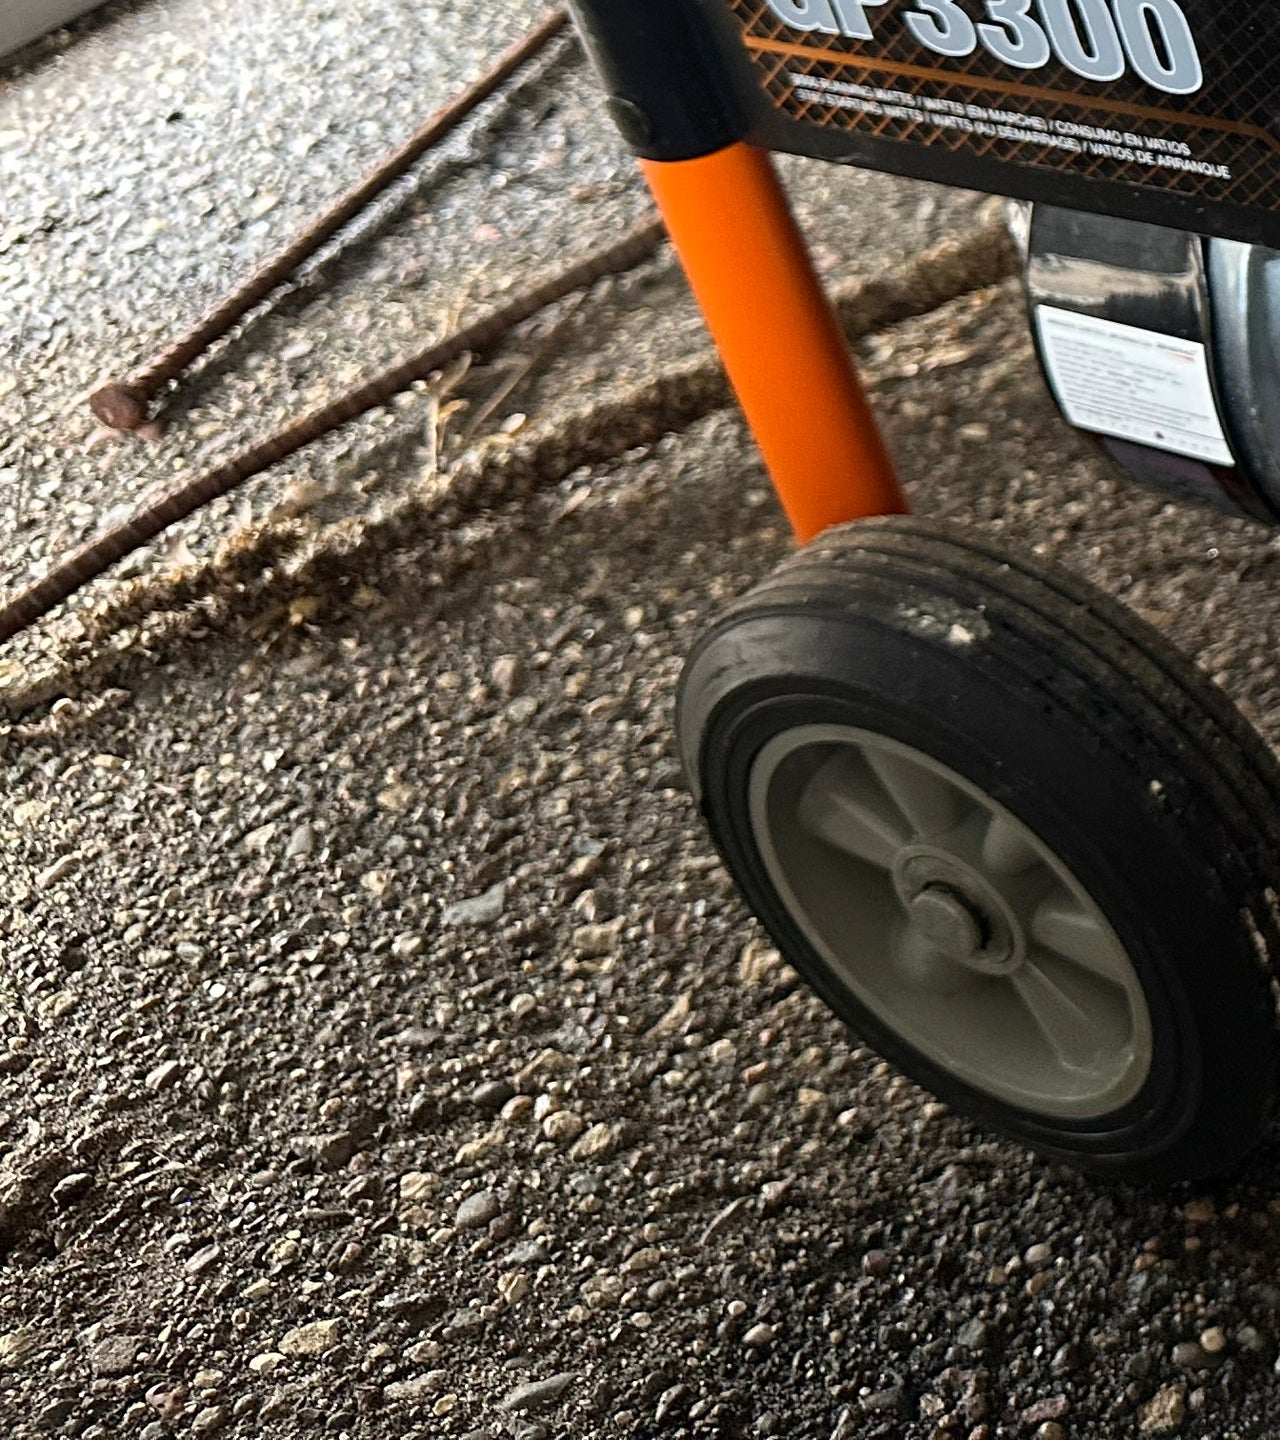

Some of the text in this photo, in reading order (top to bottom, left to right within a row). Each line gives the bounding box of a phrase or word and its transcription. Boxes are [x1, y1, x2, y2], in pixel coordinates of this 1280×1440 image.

[1055, 120, 1122, 144] CONSUMO
[1123, 132, 1144, 148] EN
[1144, 136, 1192, 157] VATIOS
[1088, 141, 1135, 162] VATIOS
[1135, 149, 1156, 166] DE
[1157, 155, 1232, 180] ARRANQUE
